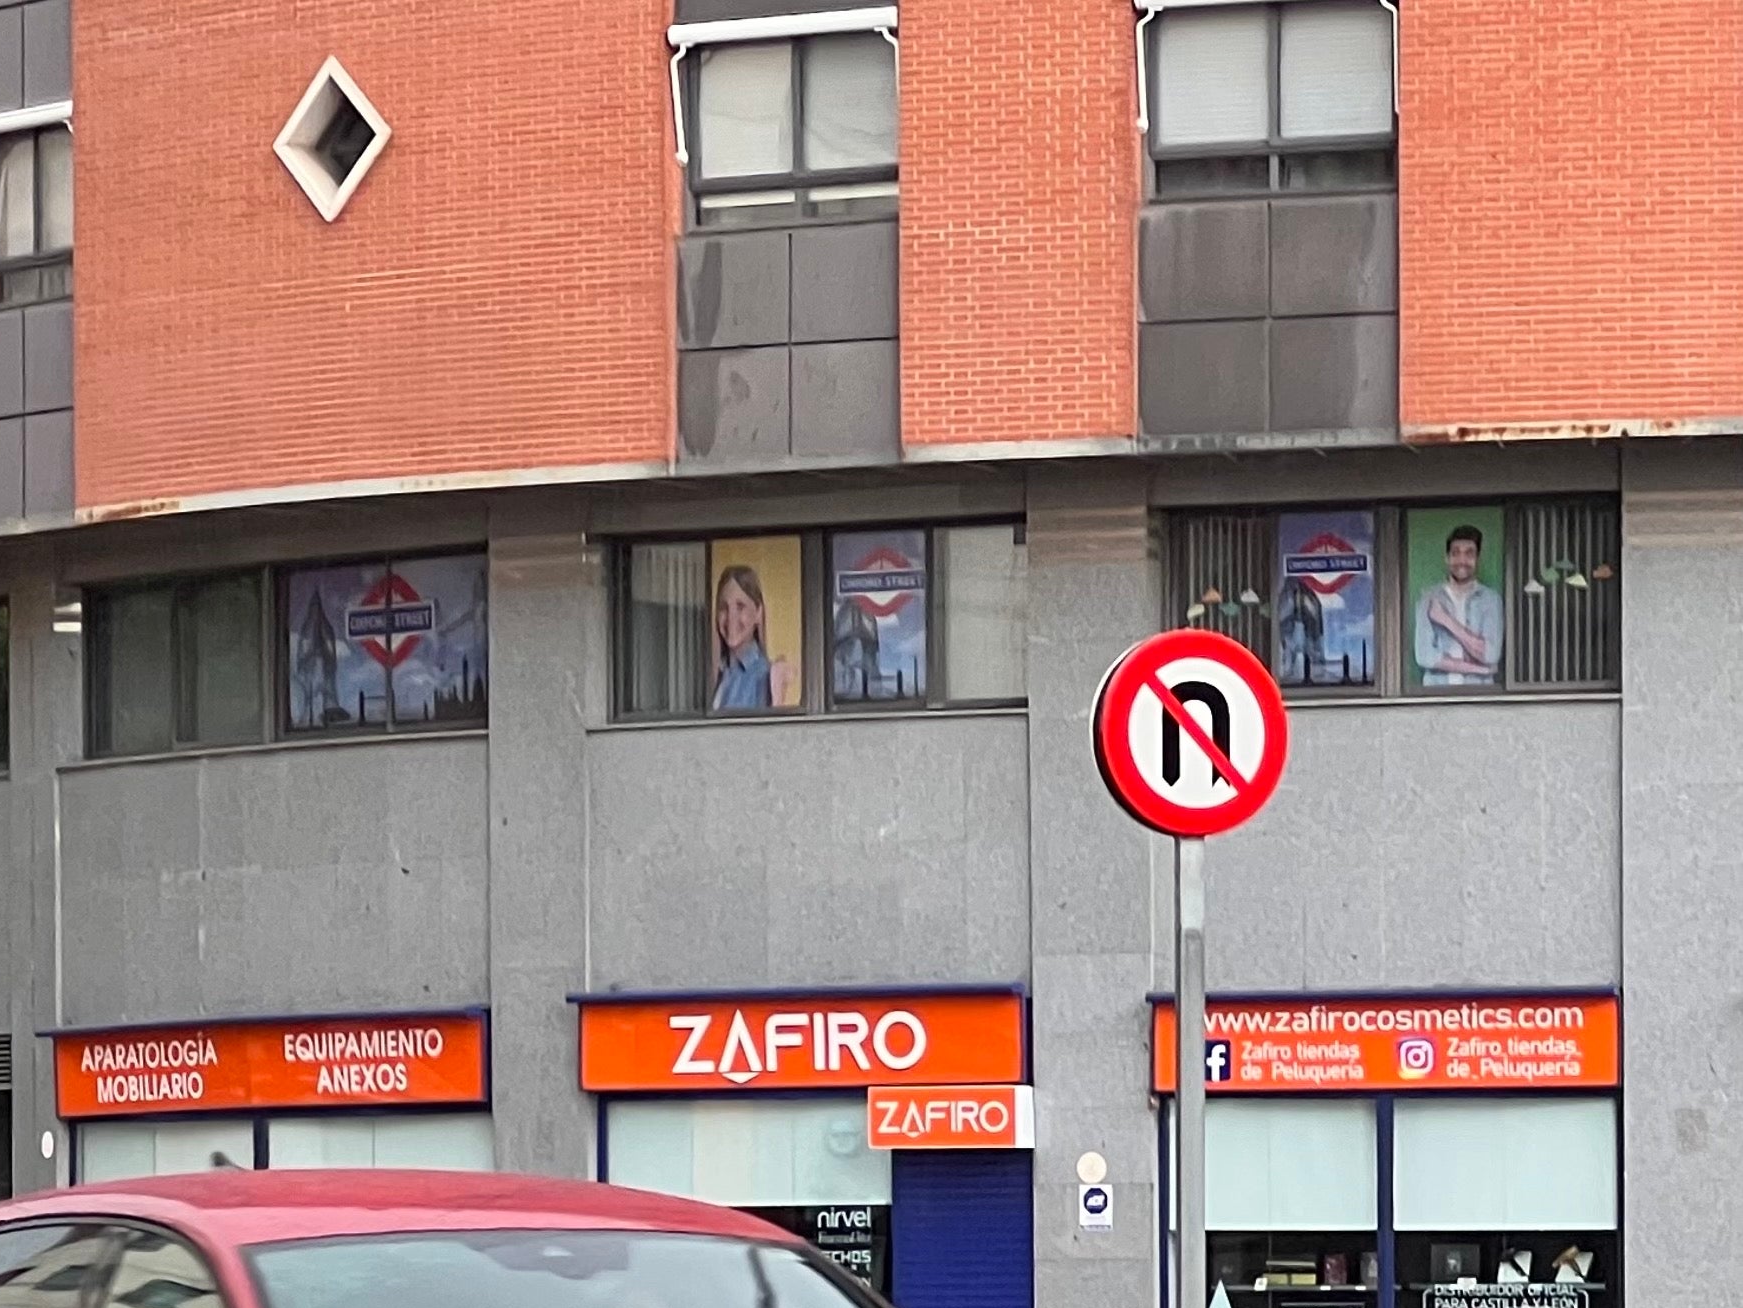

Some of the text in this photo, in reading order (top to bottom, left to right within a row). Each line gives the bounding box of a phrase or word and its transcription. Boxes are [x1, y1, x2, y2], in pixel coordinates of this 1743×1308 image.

[80, 1034, 218, 1073] APARATOLOGÍA
[282, 1027, 445, 1062] EQUIPAMIENTO
[669, 1009, 928, 1083] ZAFIRO
[1241, 1039, 1360, 1060] Zafiro tiendas
[96, 1071, 204, 1104] MOBILIARIO
[317, 1063, 408, 1095] ANEXOS
[1240, 1058, 1365, 1085] de Peluquería
[876, 1100, 1009, 1138] ZAFIRO
[817, 1206, 872, 1228] nirvel
[1434, 1283, 1578, 1297] DISTRIBUIDOR OFICIAL
